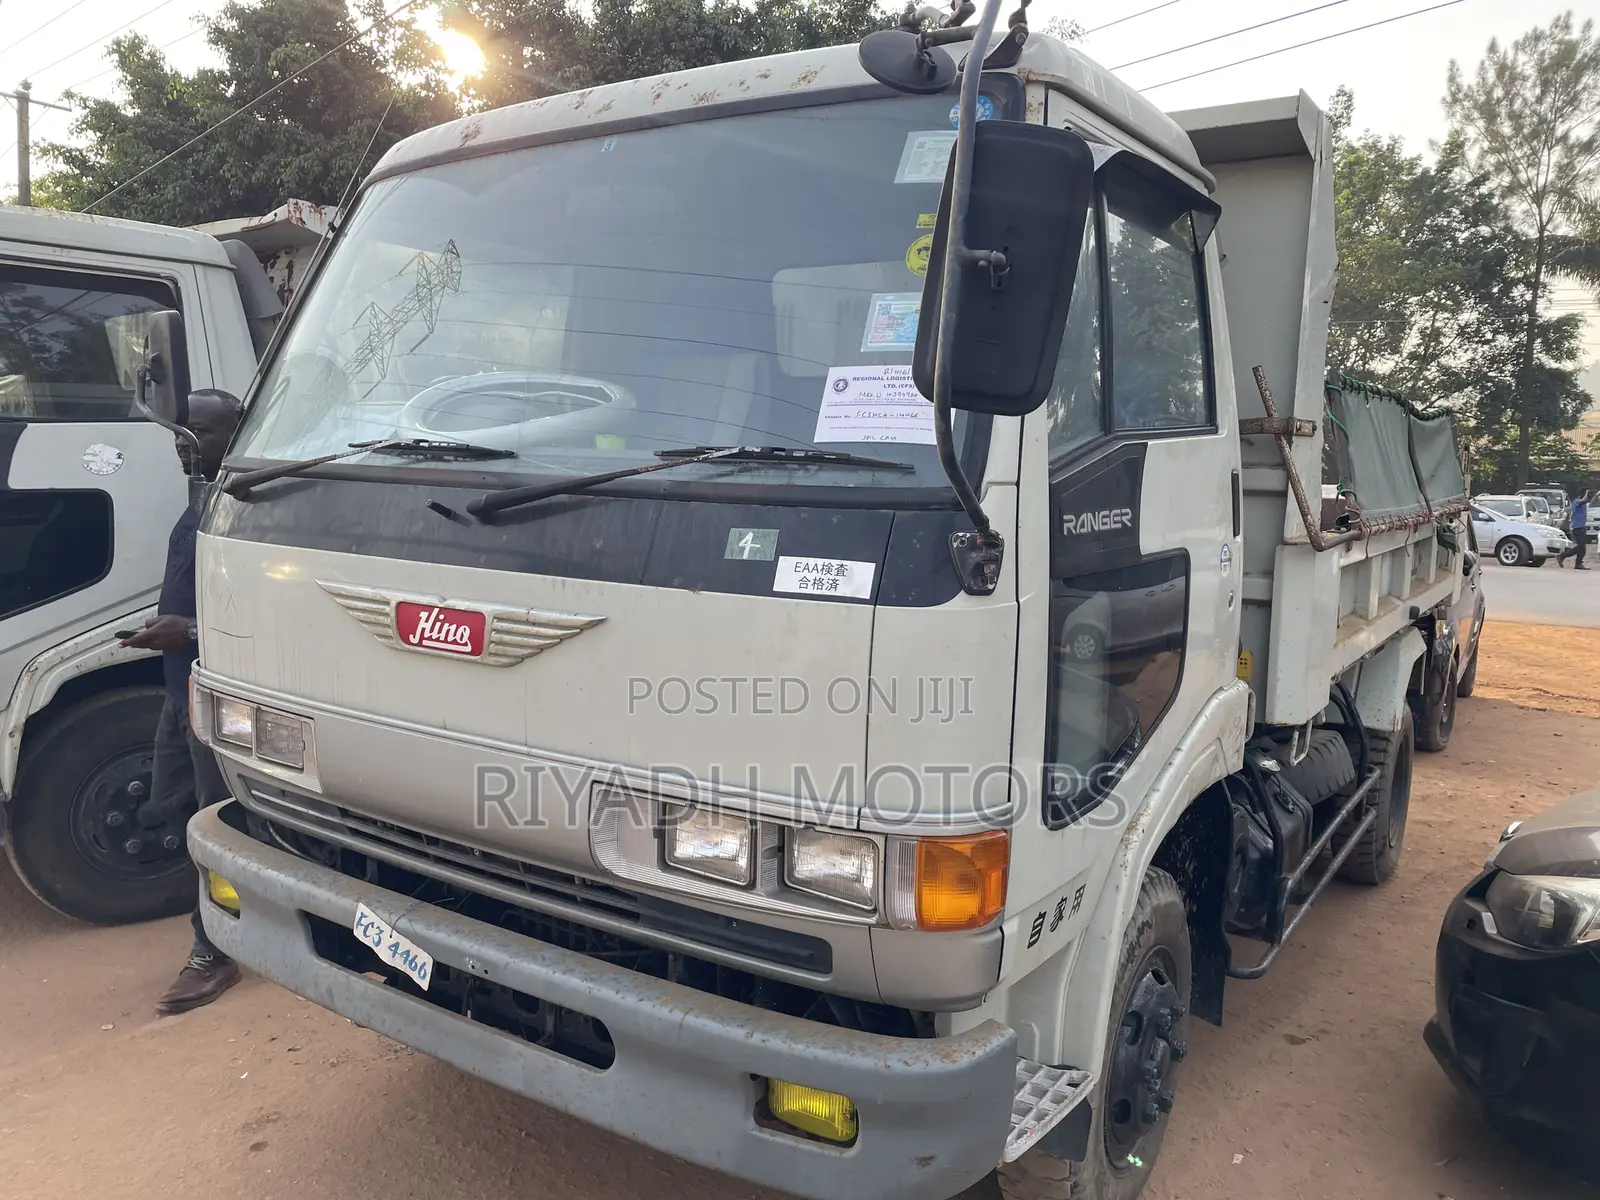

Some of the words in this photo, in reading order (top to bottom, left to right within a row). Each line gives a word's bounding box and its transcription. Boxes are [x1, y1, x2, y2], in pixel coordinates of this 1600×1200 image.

[1063, 508, 1132, 535] RANGER
[738, 531, 761, 559] 4
[794, 561, 849, 578] EAA検査
[798, 575, 840, 592] 合格済
[409, 607, 472, 653] Hino
[1027, 883, 1087, 949] 自家用
[387, 941, 427, 981] 4466
